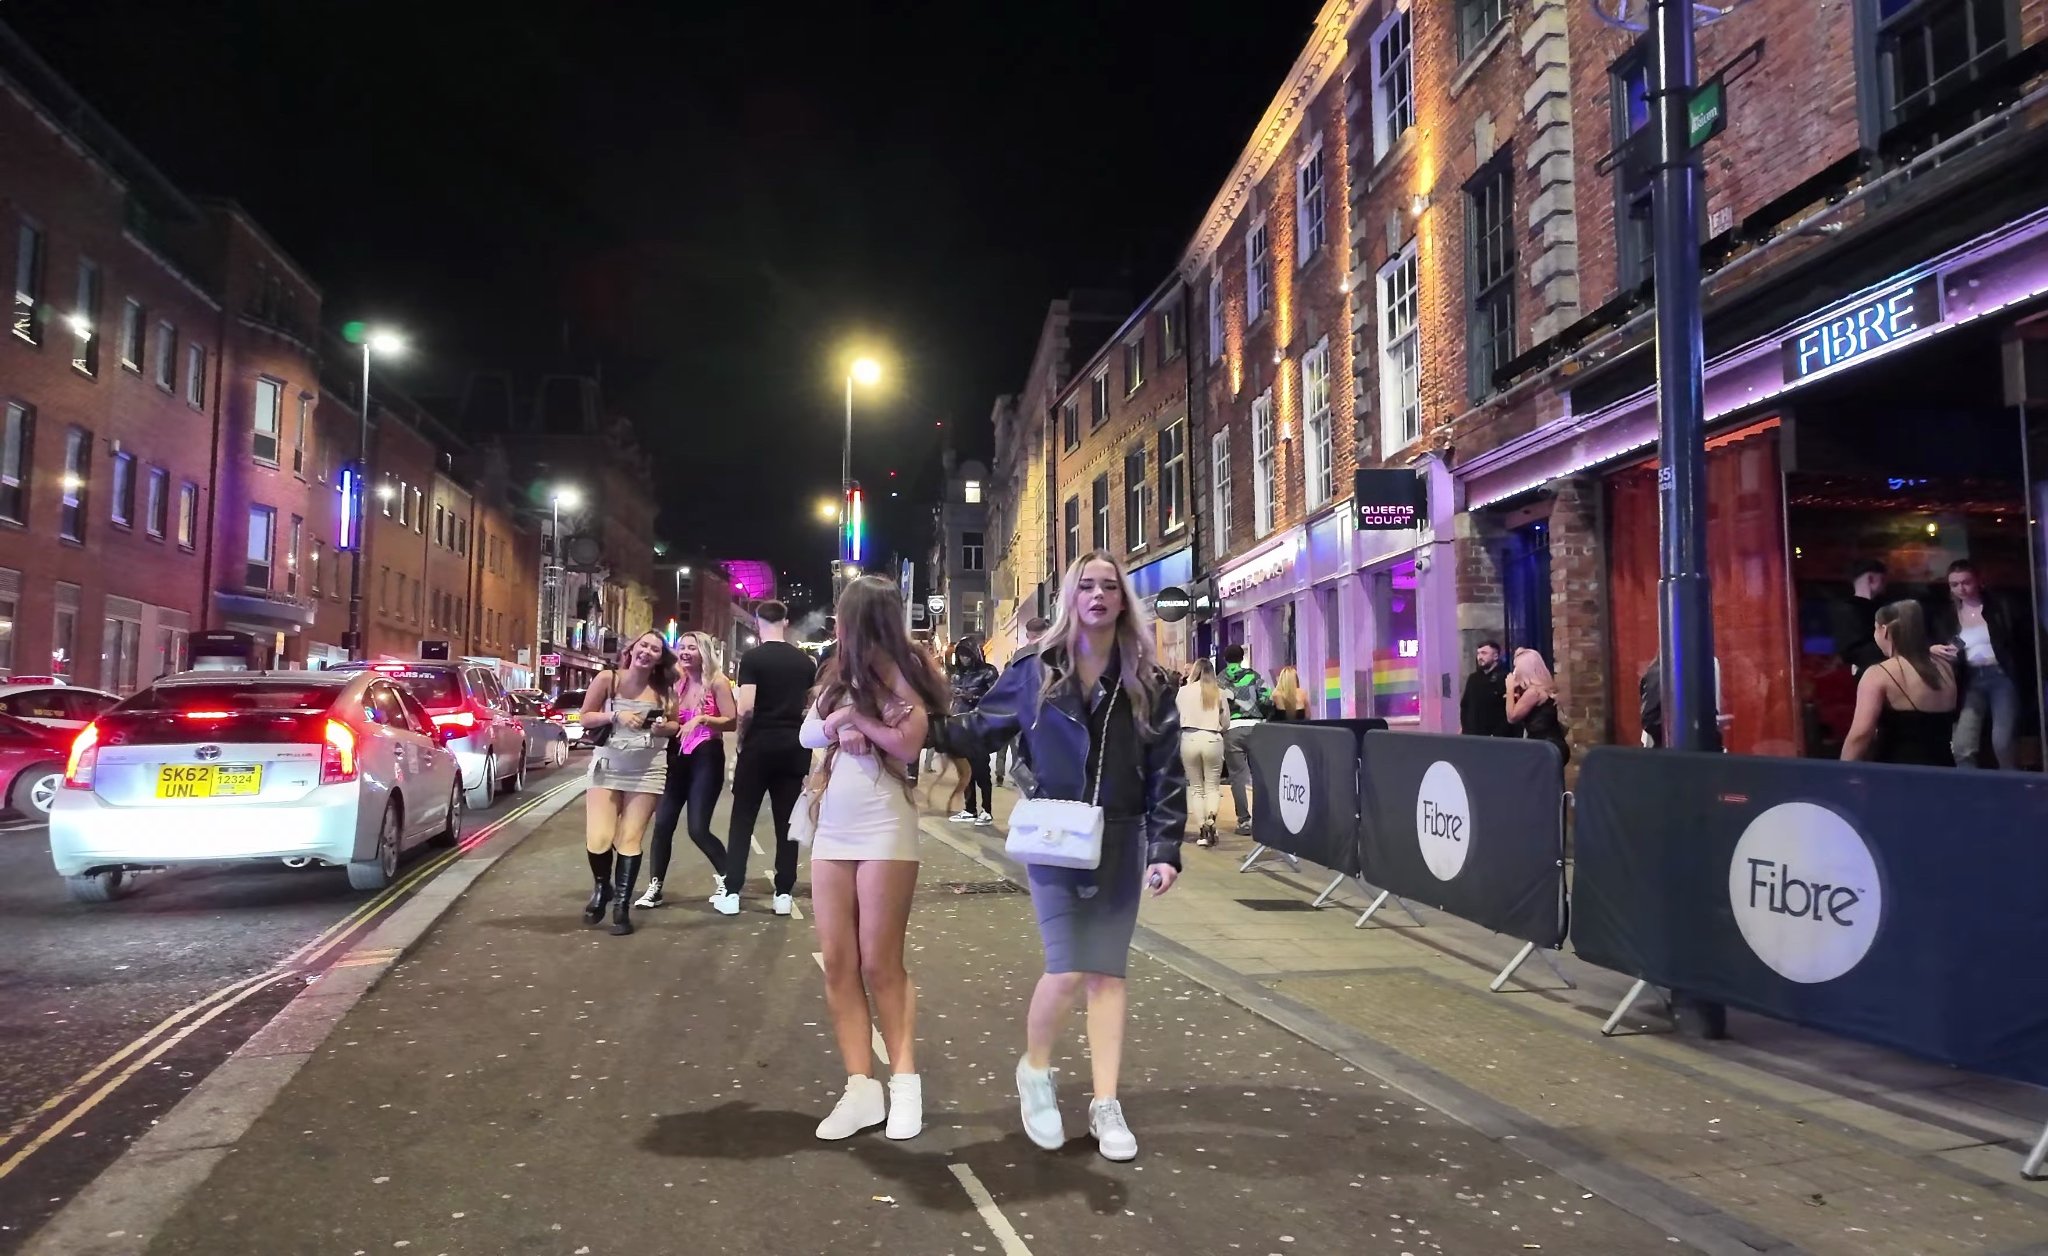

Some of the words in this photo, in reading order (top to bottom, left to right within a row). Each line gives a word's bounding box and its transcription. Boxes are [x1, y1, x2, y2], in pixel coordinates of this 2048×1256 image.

[1799, 287, 1918, 375] FIBRE
[1361, 505, 1414, 515] QUEENS
[1365, 516, 1411, 525] COURT
[162, 767, 209, 782] SK62
[217, 774, 253, 785] 12324
[165, 784, 199, 798] UNL
[1282, 774, 1306, 805] Fibre
[1423, 799, 1463, 842] Fibre
[1747, 857, 1860, 927] Fibre
